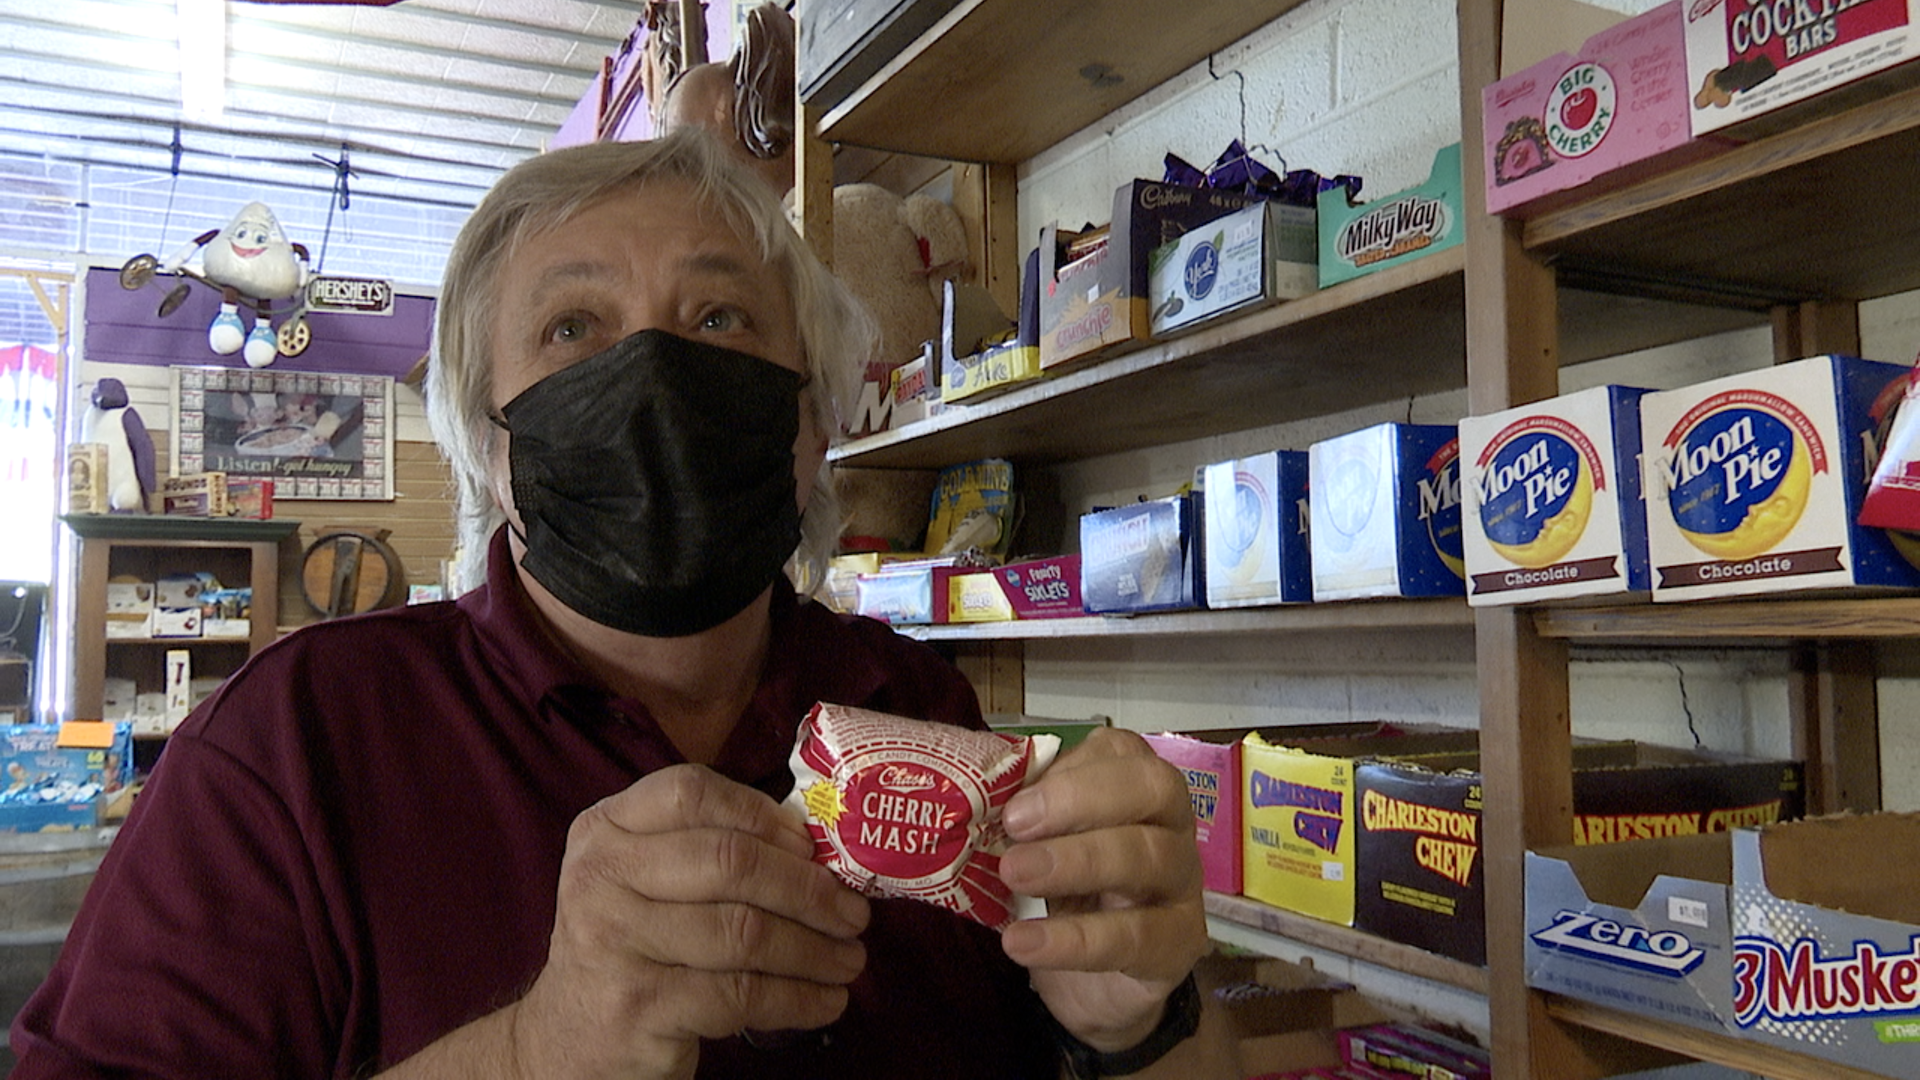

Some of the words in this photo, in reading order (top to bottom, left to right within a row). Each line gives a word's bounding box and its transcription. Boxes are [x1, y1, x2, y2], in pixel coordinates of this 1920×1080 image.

[1786, 19, 1837, 59] BARS
[1560, 67, 1595, 96] BIG
[1549, 108, 1611, 153] CHERRY
[1470, 438, 1550, 514] Moon
[1655, 416, 1755, 500] Moon
[1722, 445, 1783, 504] Pie
[1523, 466, 1571, 519] Pie
[1504, 564, 1579, 586] Chocolate
[1698, 557, 1792, 581] Chocolate
[862, 791, 947, 829] CHERRY
[1362, 788, 1478, 844] CHARLESTON
[859, 820, 941, 856] MASH
[1250, 826, 1280, 849] VANILLA
[1415, 836, 1478, 888] CHEW
[1532, 909, 1704, 974] Zero
[1735, 951, 1760, 1013] 3
